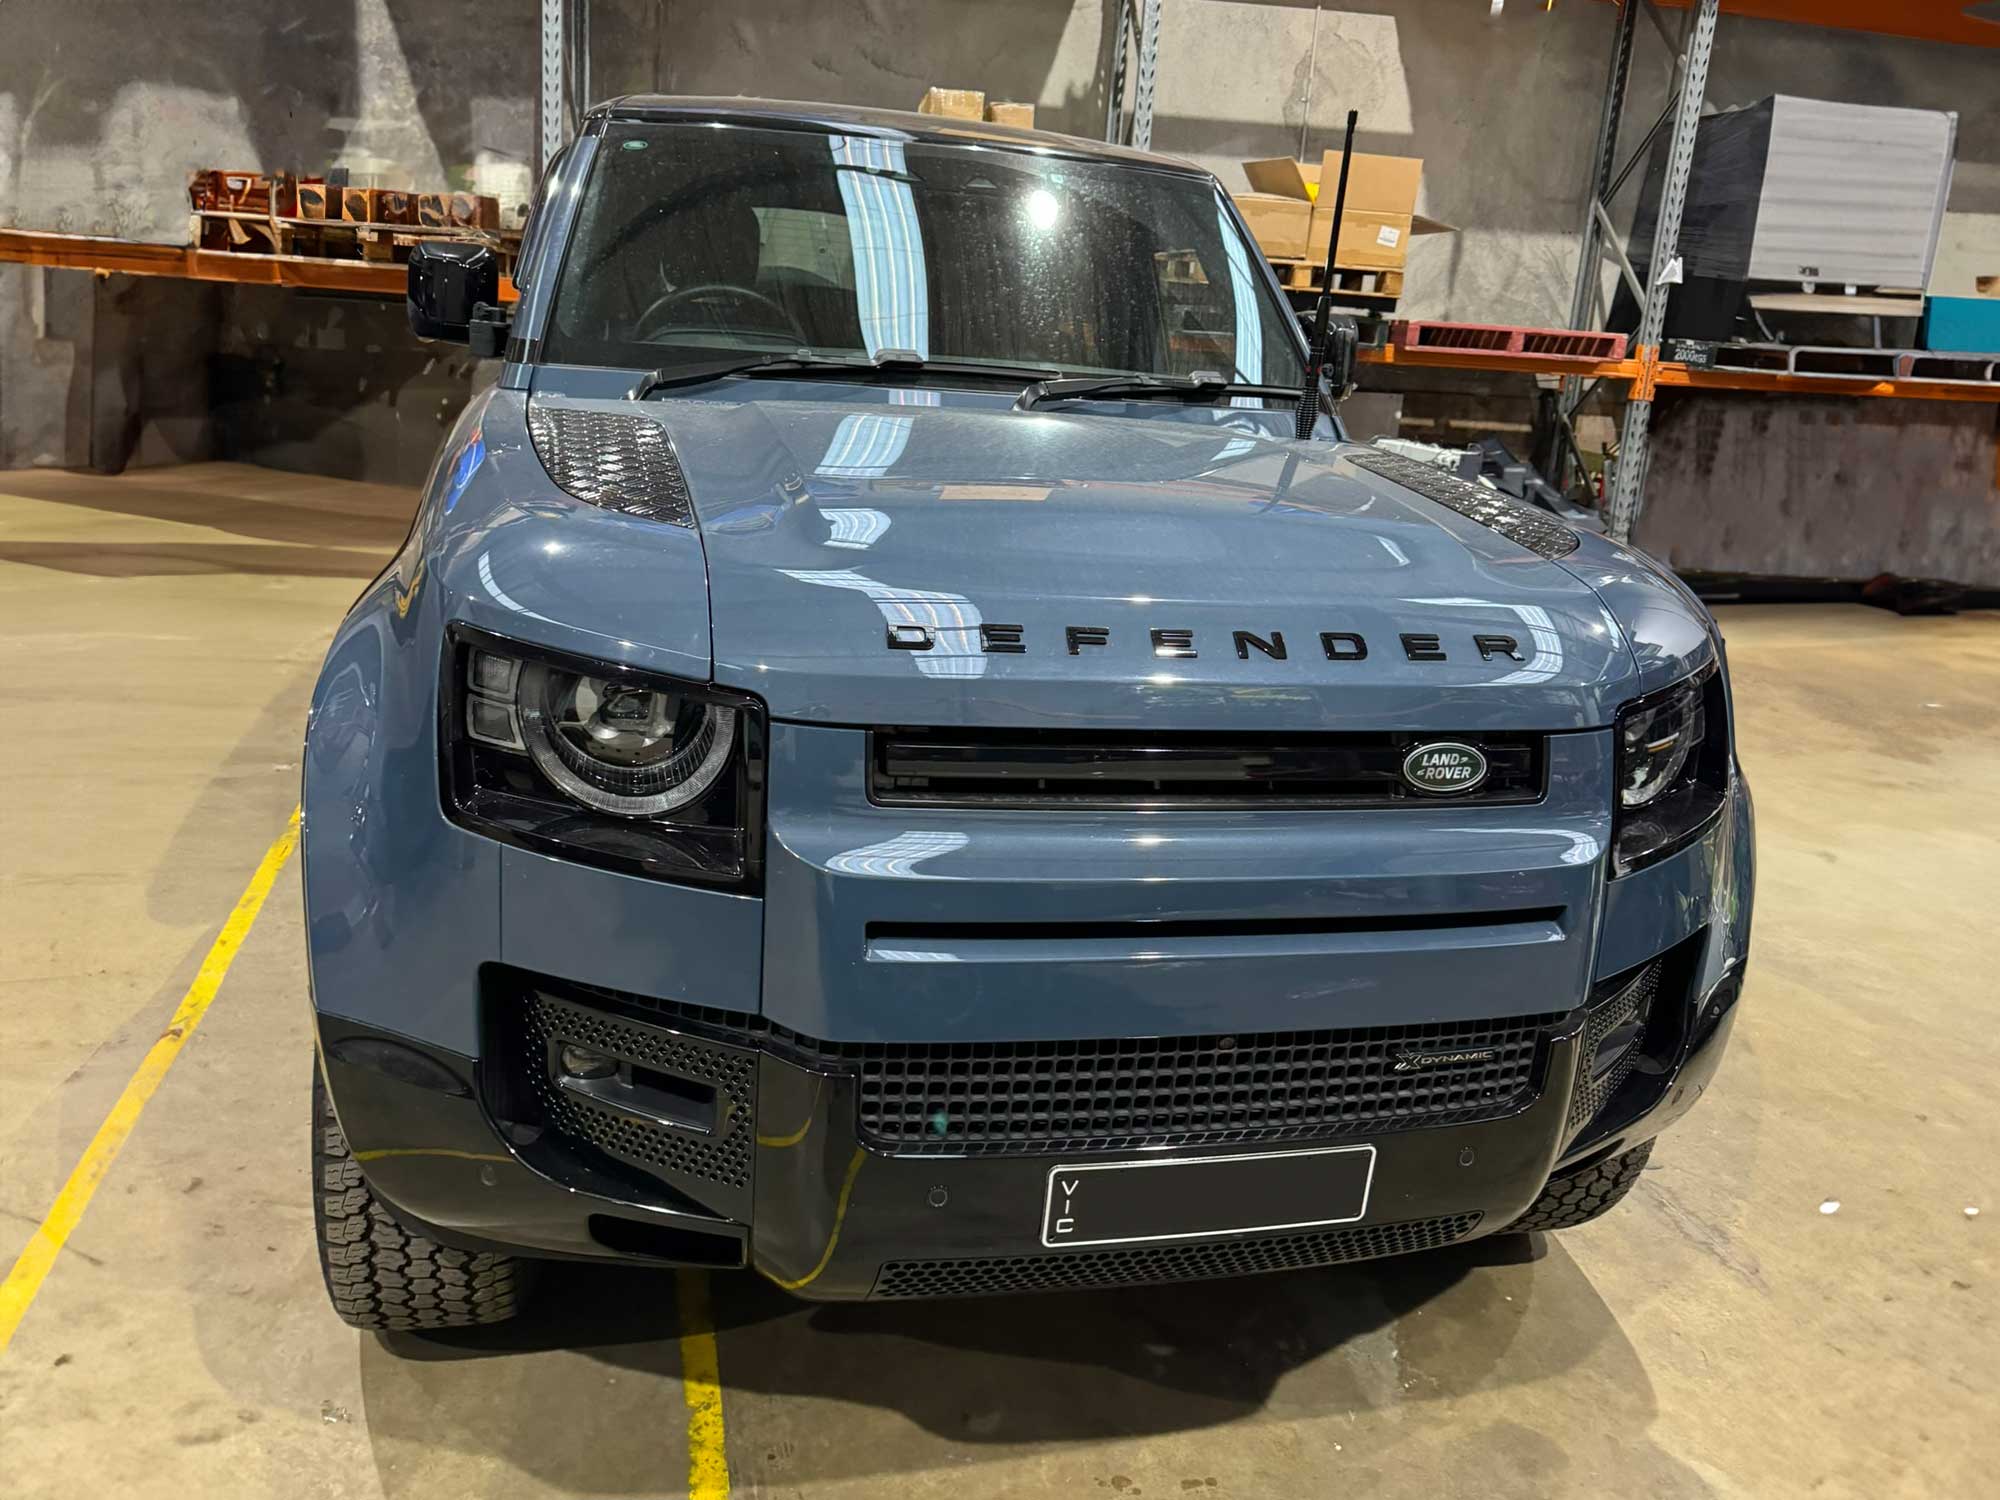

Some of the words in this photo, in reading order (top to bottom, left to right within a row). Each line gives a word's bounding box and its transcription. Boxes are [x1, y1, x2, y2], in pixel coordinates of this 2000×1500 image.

[886, 622, 1525, 661] DEFENDER
[1421, 753, 1460, 767] LAND
[1424, 766, 1472, 780] ROVER
[1056, 1180, 1079, 1233] VIC
